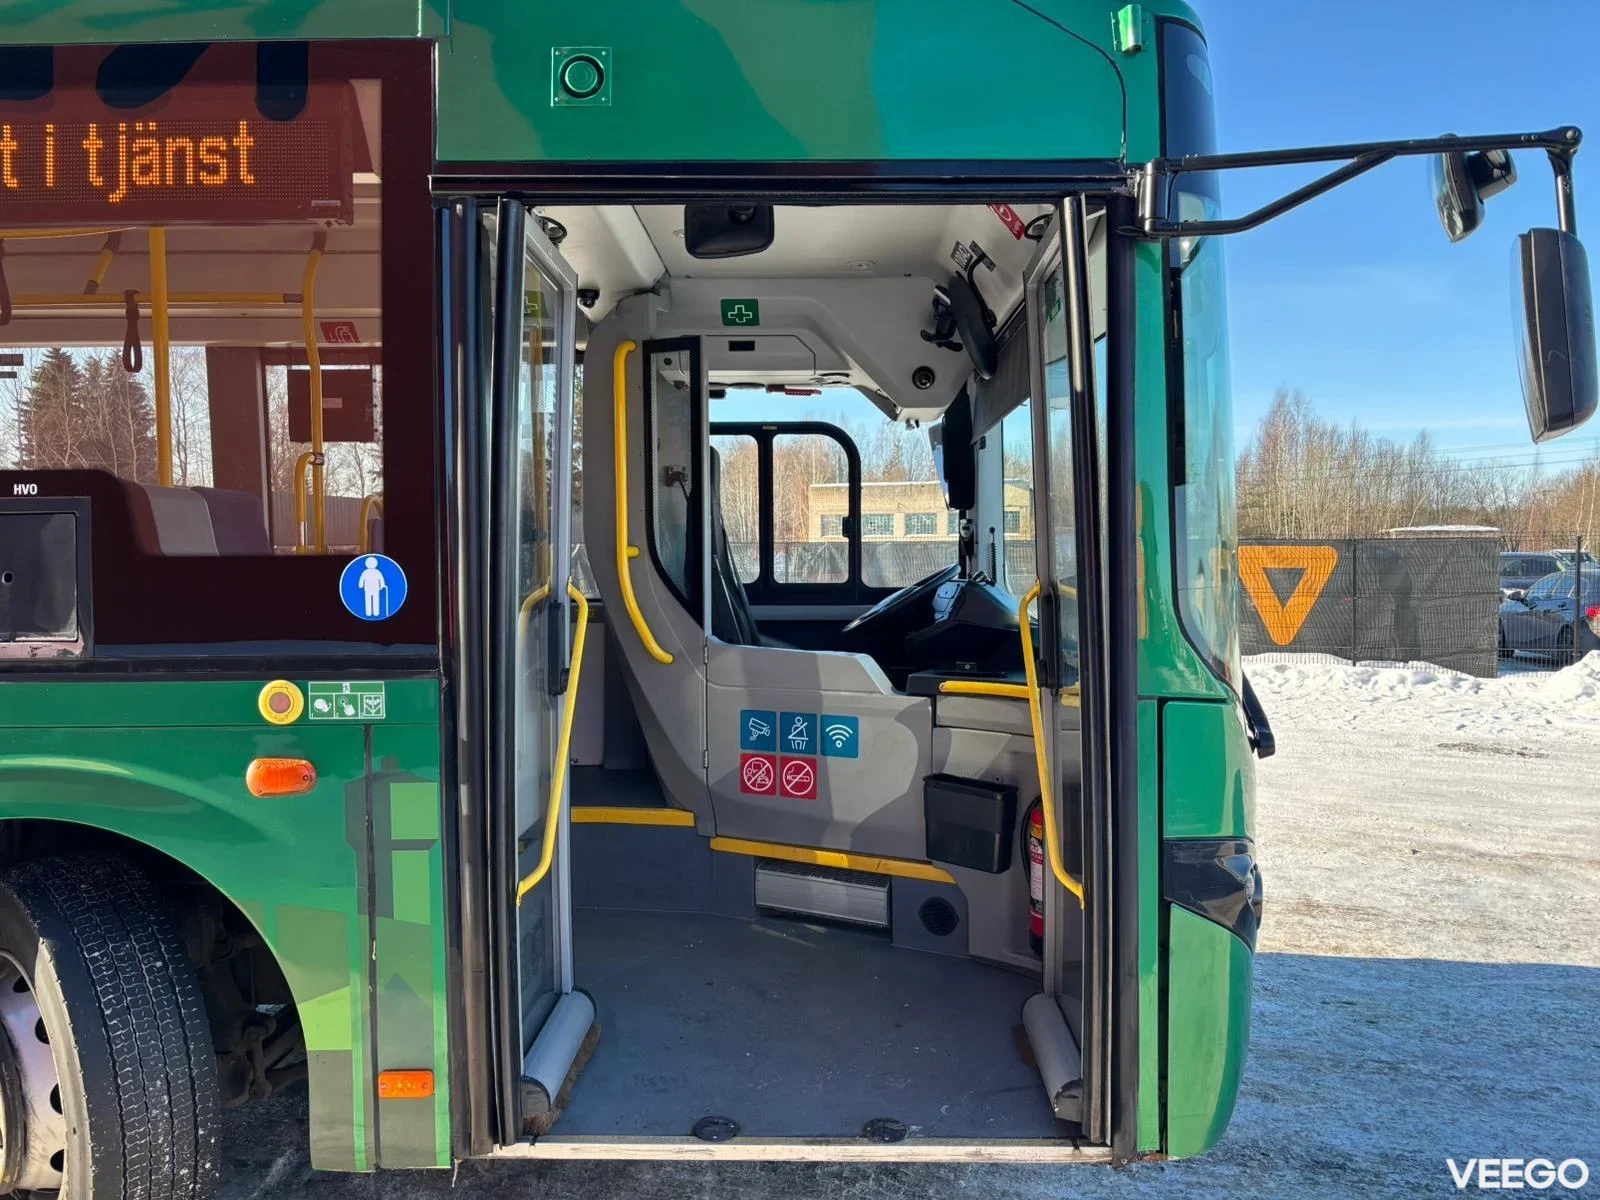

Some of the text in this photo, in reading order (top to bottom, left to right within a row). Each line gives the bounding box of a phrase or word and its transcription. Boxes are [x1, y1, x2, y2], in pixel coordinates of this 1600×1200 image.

[45, 123, 55, 188] i
[82, 120, 256, 204] tjänst
[13, 483, 38, 496] HVO
